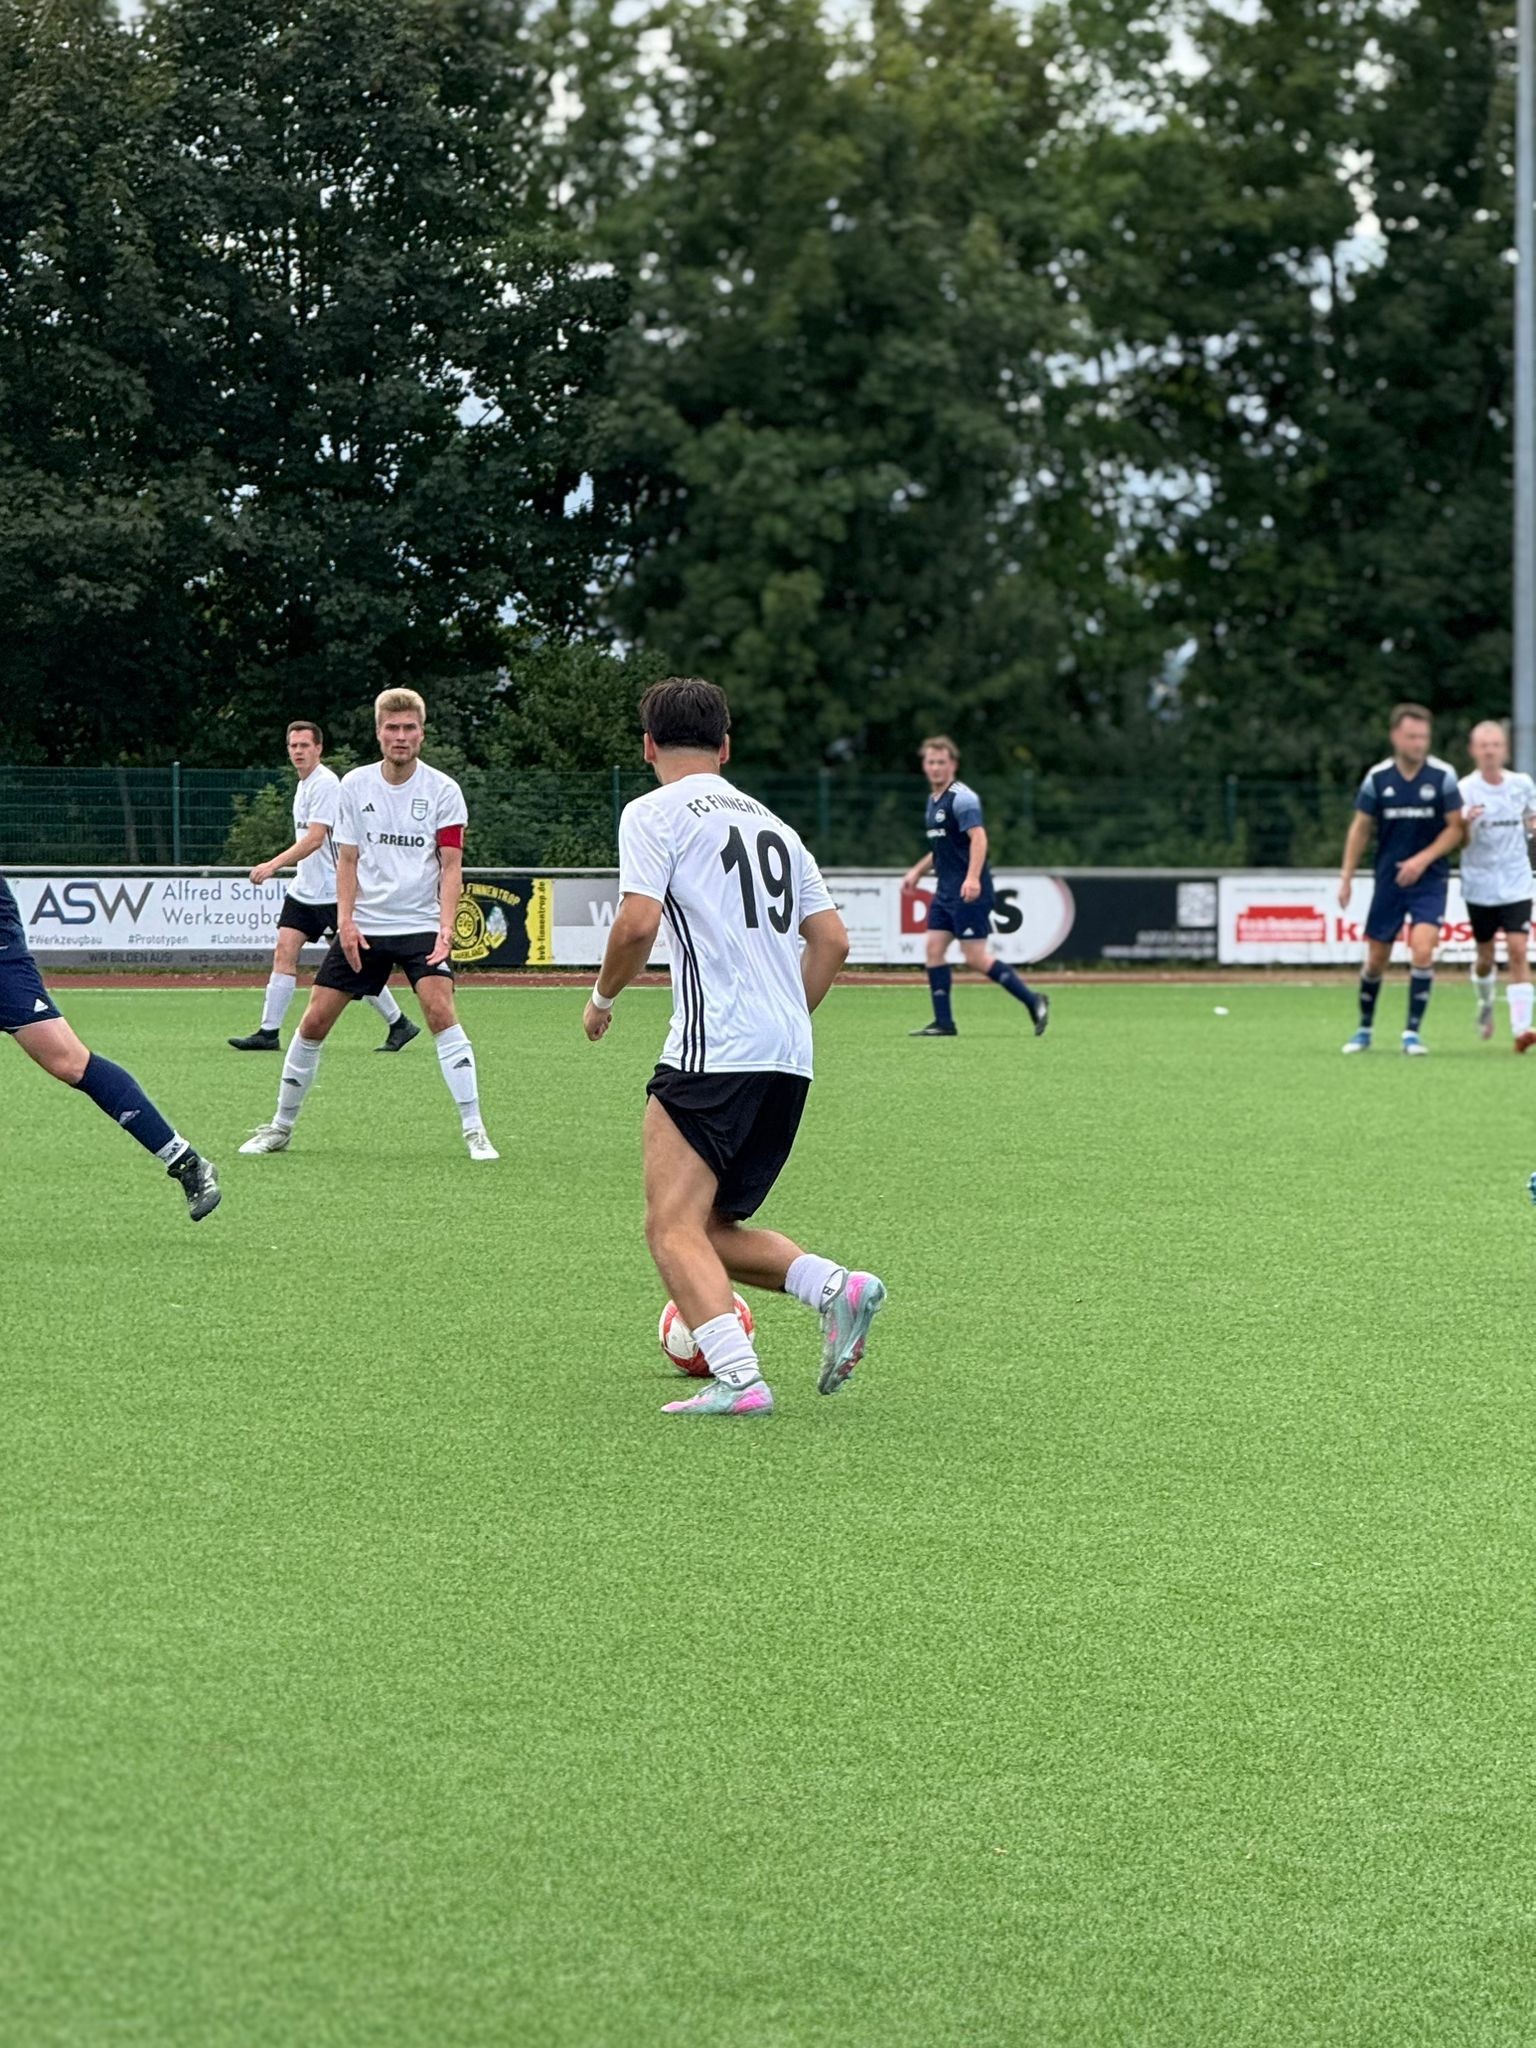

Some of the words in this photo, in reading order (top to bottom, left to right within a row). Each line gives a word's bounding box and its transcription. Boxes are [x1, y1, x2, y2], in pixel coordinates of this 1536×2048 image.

[686, 799, 711, 818] FC
[162, 879, 222, 901] Alfred
[720, 825, 794, 935] 19
[29, 881, 154, 925] ASW
[901, 888, 1024, 935] DS
[128, 932, 189, 946] #Prototypen
[89, 951, 108, 963] WIR
